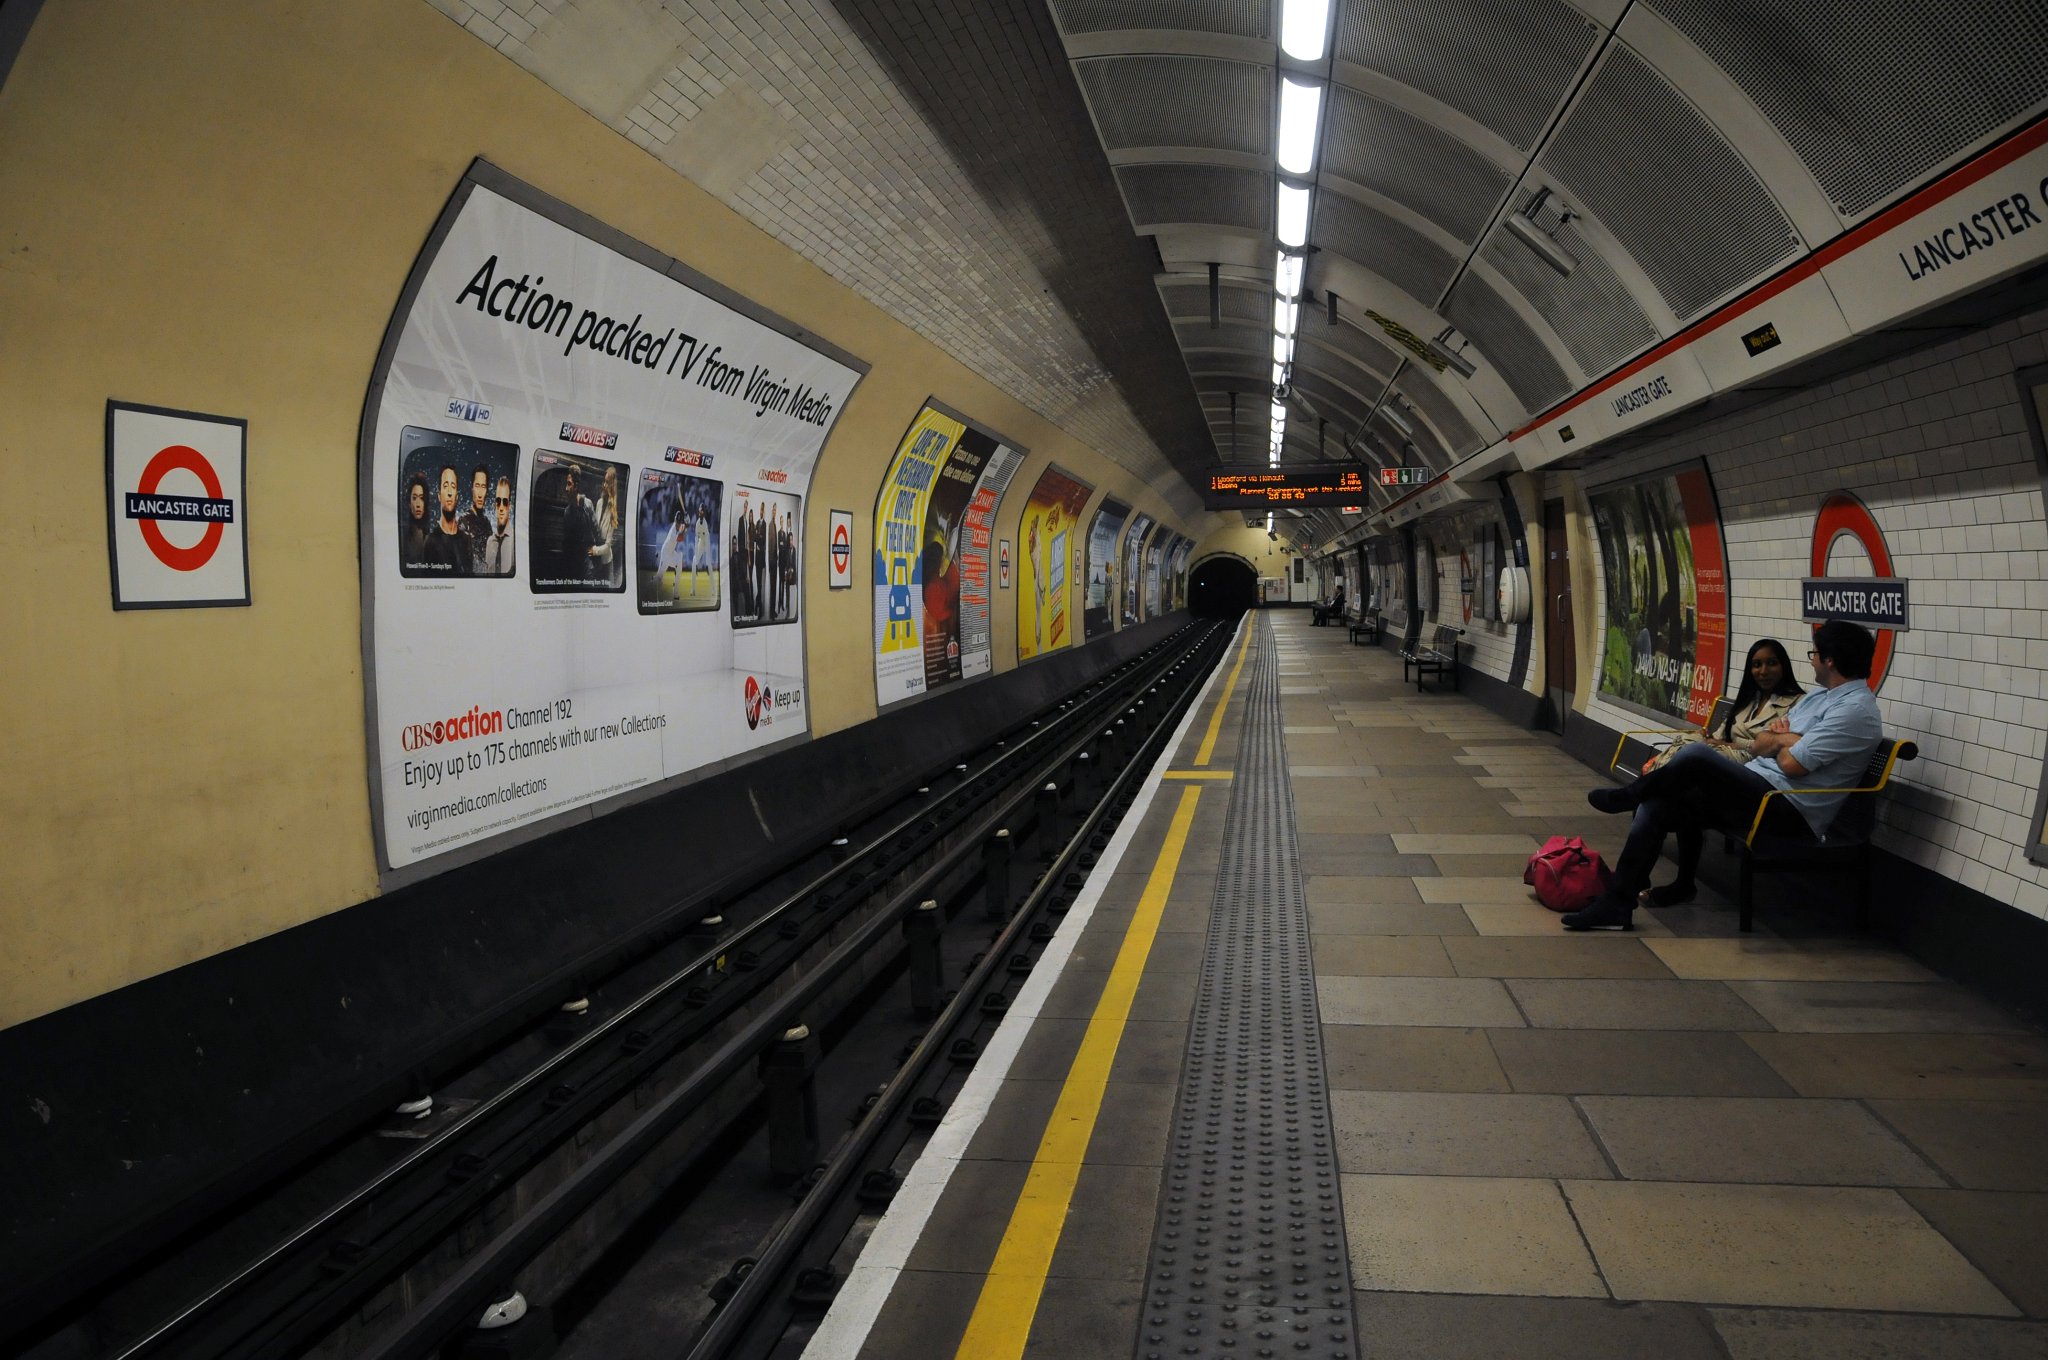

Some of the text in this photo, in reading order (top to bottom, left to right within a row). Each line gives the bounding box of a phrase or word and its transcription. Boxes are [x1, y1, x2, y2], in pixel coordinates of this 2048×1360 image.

[1899, 193, 2042, 281] LANCASTER
[455, 254, 832, 427] Action packed TV from Virgin Media
[1610, 375, 1672, 418] LANCASTER GATE
[448, 400, 465, 417] sky
[478, 409, 490, 420] HD
[562, 424, 616, 447] sky MOVIES HD
[666, 447, 676, 464] sky
[677, 450, 700, 466] SPORTS
[1211, 482, 1217, 490] 2
[1217, 482, 1238, 490] Epping
[1340, 478, 1346, 486] 5
[1217, 475, 1247, 483] Woodford
[130, 498, 231, 518] LANCASTER GATE
[1807, 590, 1902, 616] LANCASTER GATE
[1635, 652, 1715, 693] DAVID NASH AT KEW
[775, 689, 801, 710] Keep up
[1670, 691, 1676, 707] A
[1675, 691, 1698, 713] Natural
[402, 698, 572, 752] CBS action Channel 192
[404, 712, 667, 789] Enjoy up to 175 channels with our new Collections
[407, 776, 548, 831] virginmedia.com/collections
